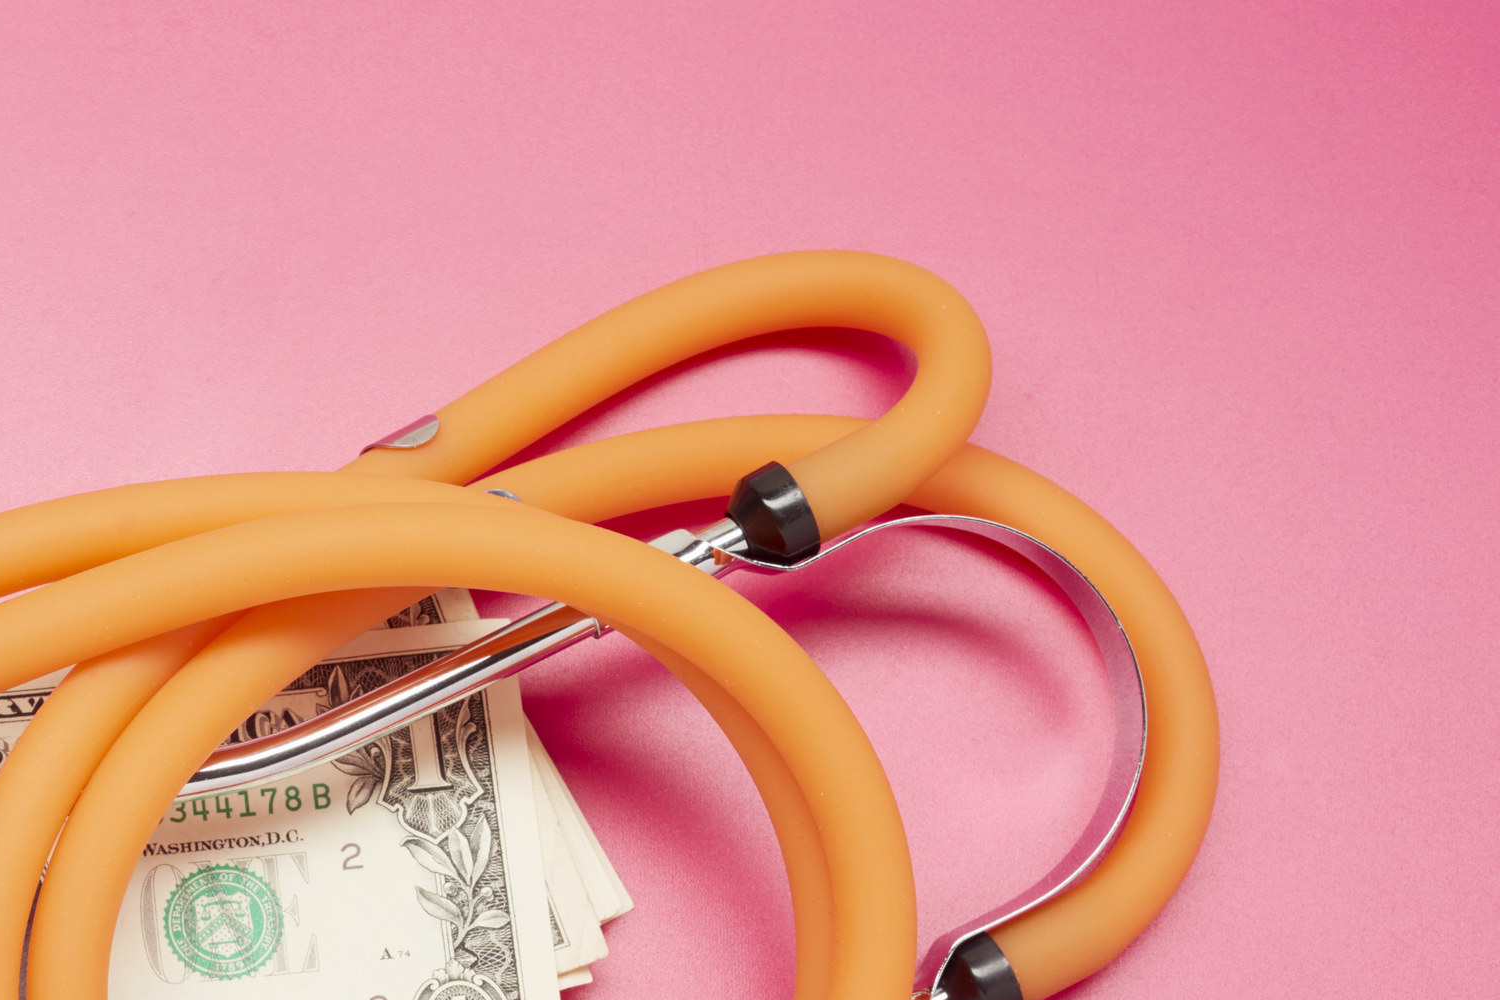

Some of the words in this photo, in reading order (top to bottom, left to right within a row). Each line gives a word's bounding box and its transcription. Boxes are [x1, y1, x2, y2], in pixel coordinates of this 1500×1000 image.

[160, 782, 332, 824] 344178B
[341, 843, 364, 871] 2
[219, 872, 236, 882] OF
[379, 948, 394, 960] A
